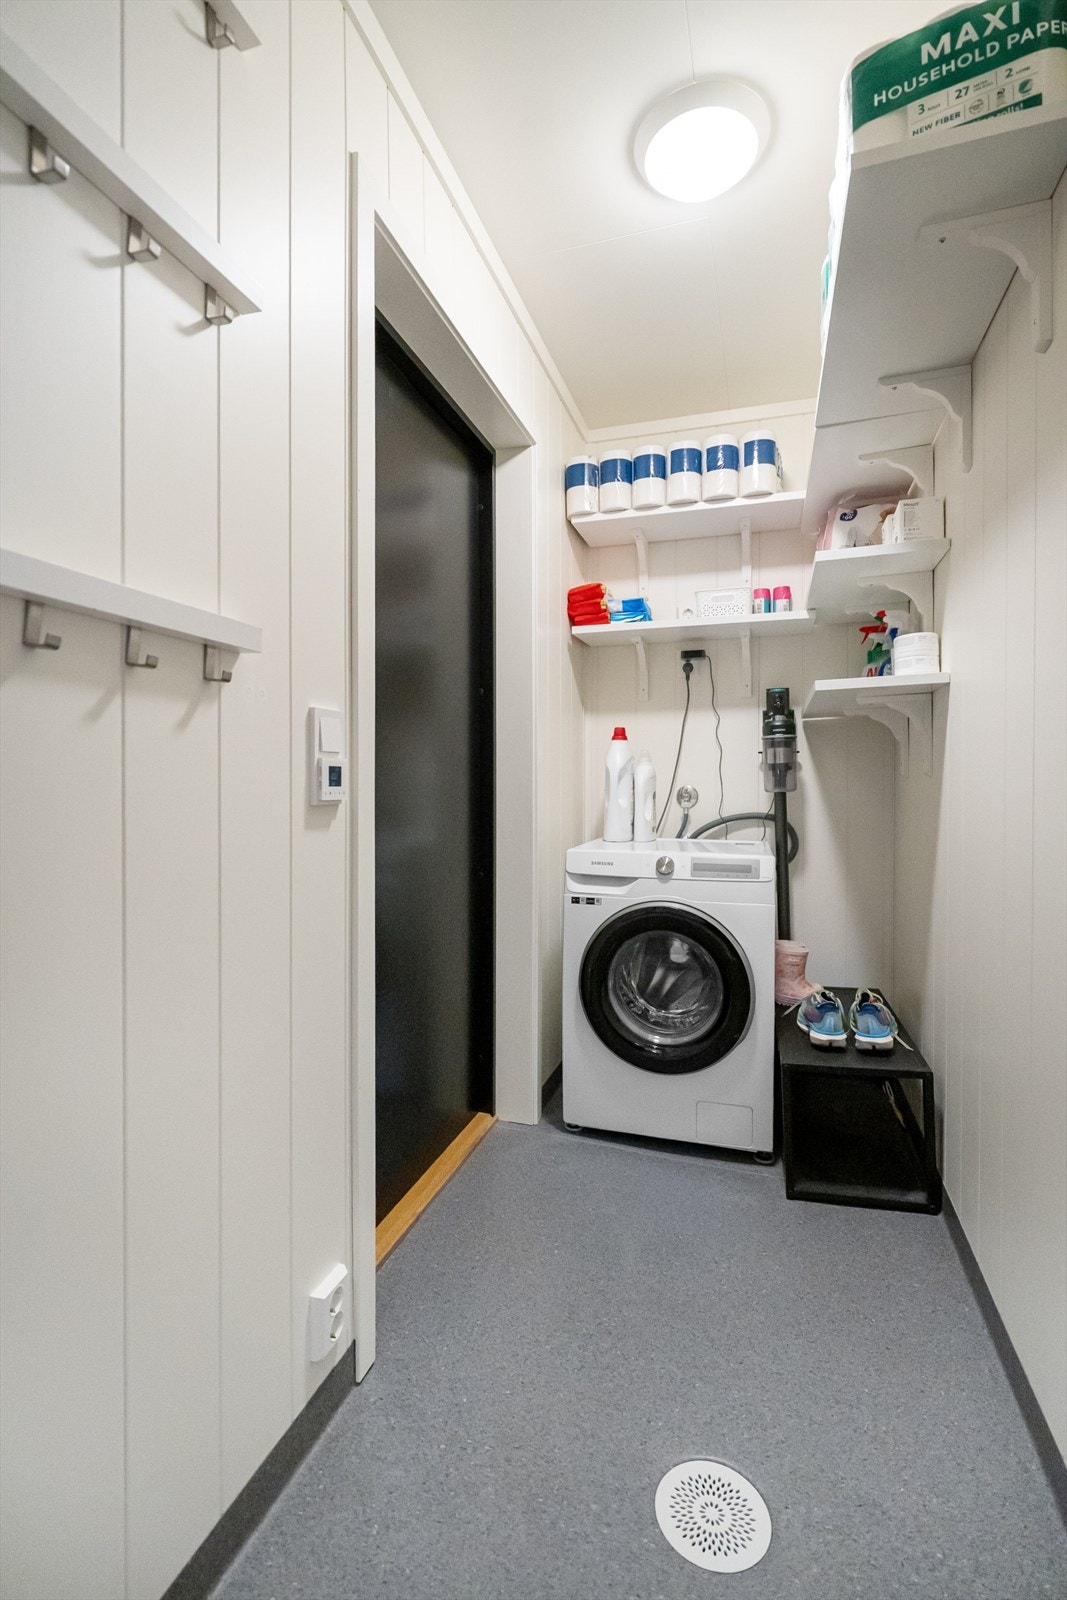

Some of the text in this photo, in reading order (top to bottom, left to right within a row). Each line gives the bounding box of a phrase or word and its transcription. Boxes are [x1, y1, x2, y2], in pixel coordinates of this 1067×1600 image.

[921, 1, 1020, 65] MAXI
[873, 20, 1067, 107] HOUSEHOLD PAPER
[1005, 68, 1013, 78] 2
[954, 86, 970, 99] 27
[917, 104, 925, 115] 3
[912, 122, 933, 136] NEW
[935, 111, 960, 126] FIBER
